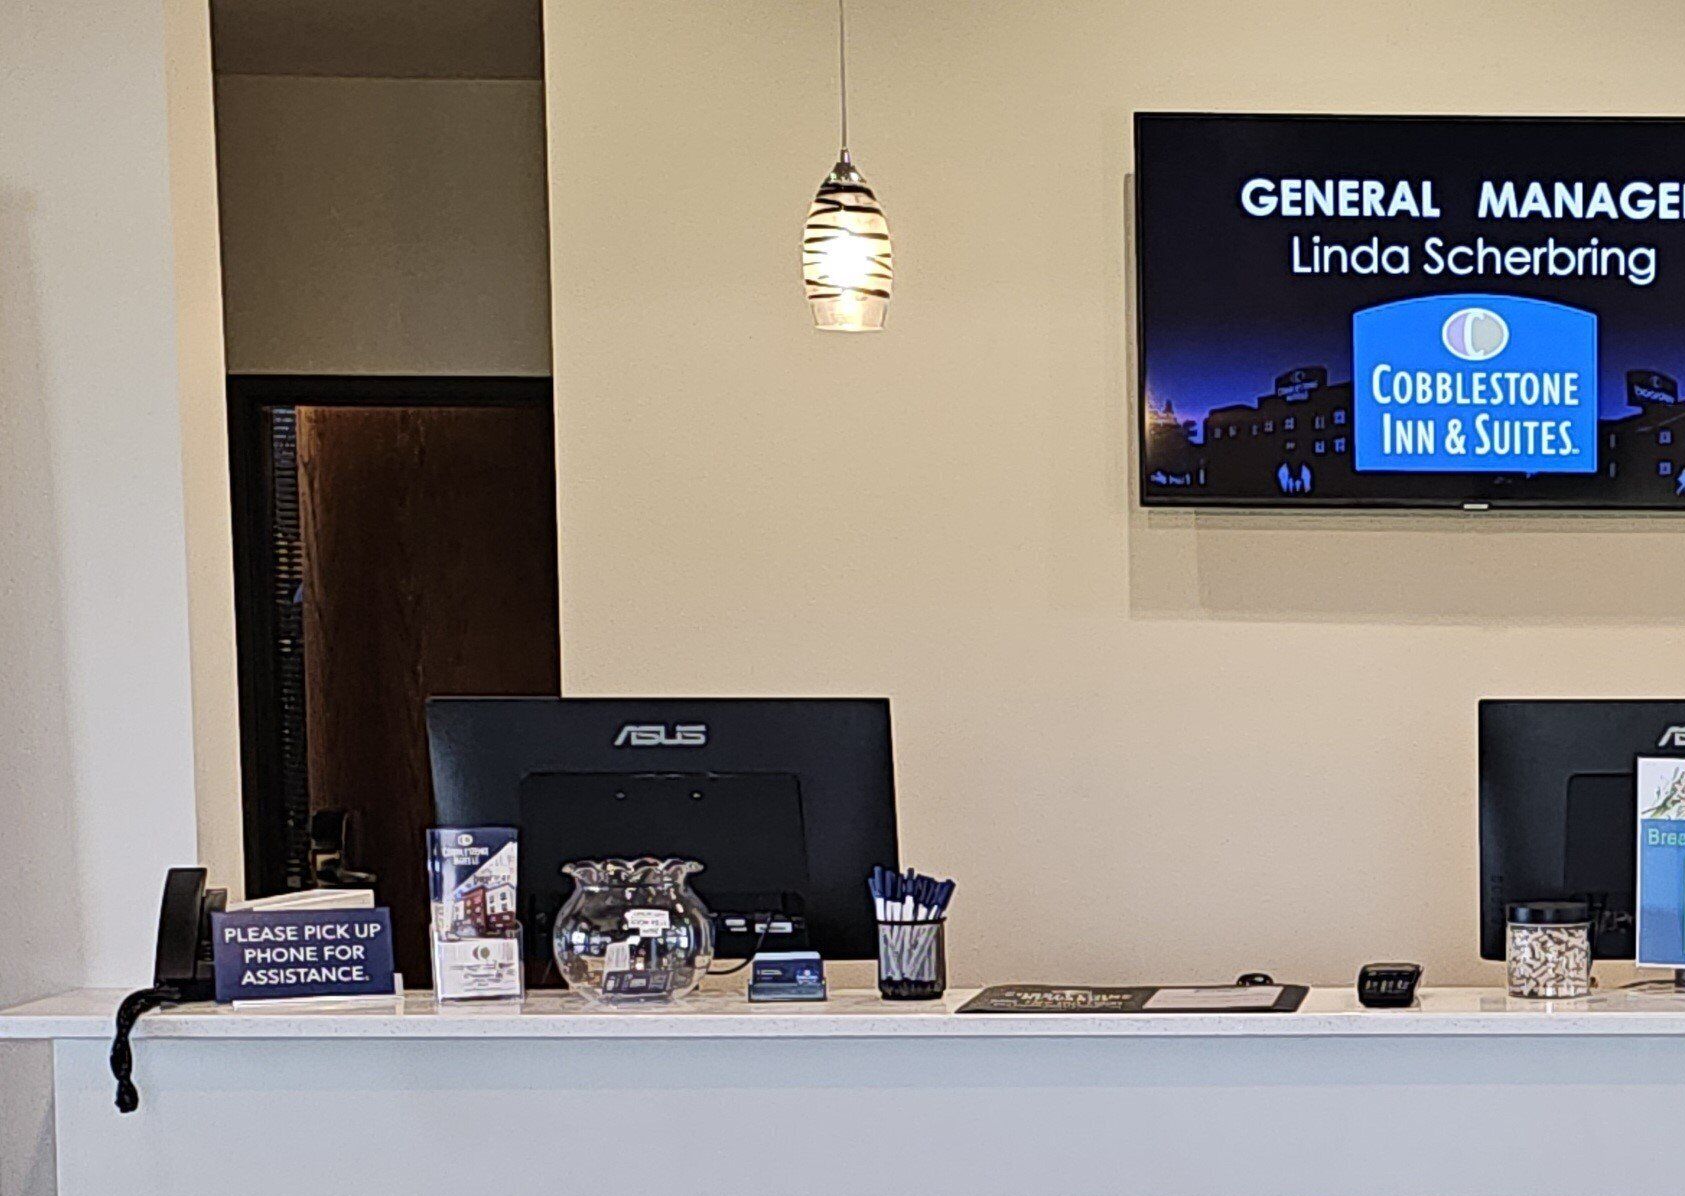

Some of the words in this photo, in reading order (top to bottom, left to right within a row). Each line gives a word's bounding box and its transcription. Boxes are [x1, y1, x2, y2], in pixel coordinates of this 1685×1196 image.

[1240, 178, 1440, 218] GENERAL
[1292, 236, 1410, 275] Linda
[1424, 237, 1657, 285] Scherbring
[1371, 365, 1580, 407] COBBLESTONE
[1382, 414, 1436, 455] INN
[1444, 418, 1467, 455] &
[1474, 414, 1573, 456] SUITES
[614, 723, 707, 747] ASUS
[224, 926, 299, 943] PLEASE
[304, 924, 350, 940] PICK
[354, 923, 381, 938] UP
[244, 946, 318, 964] PHONE
[324, 945, 365, 961] FOR
[241, 966, 370, 985] ASSISTANCE.
